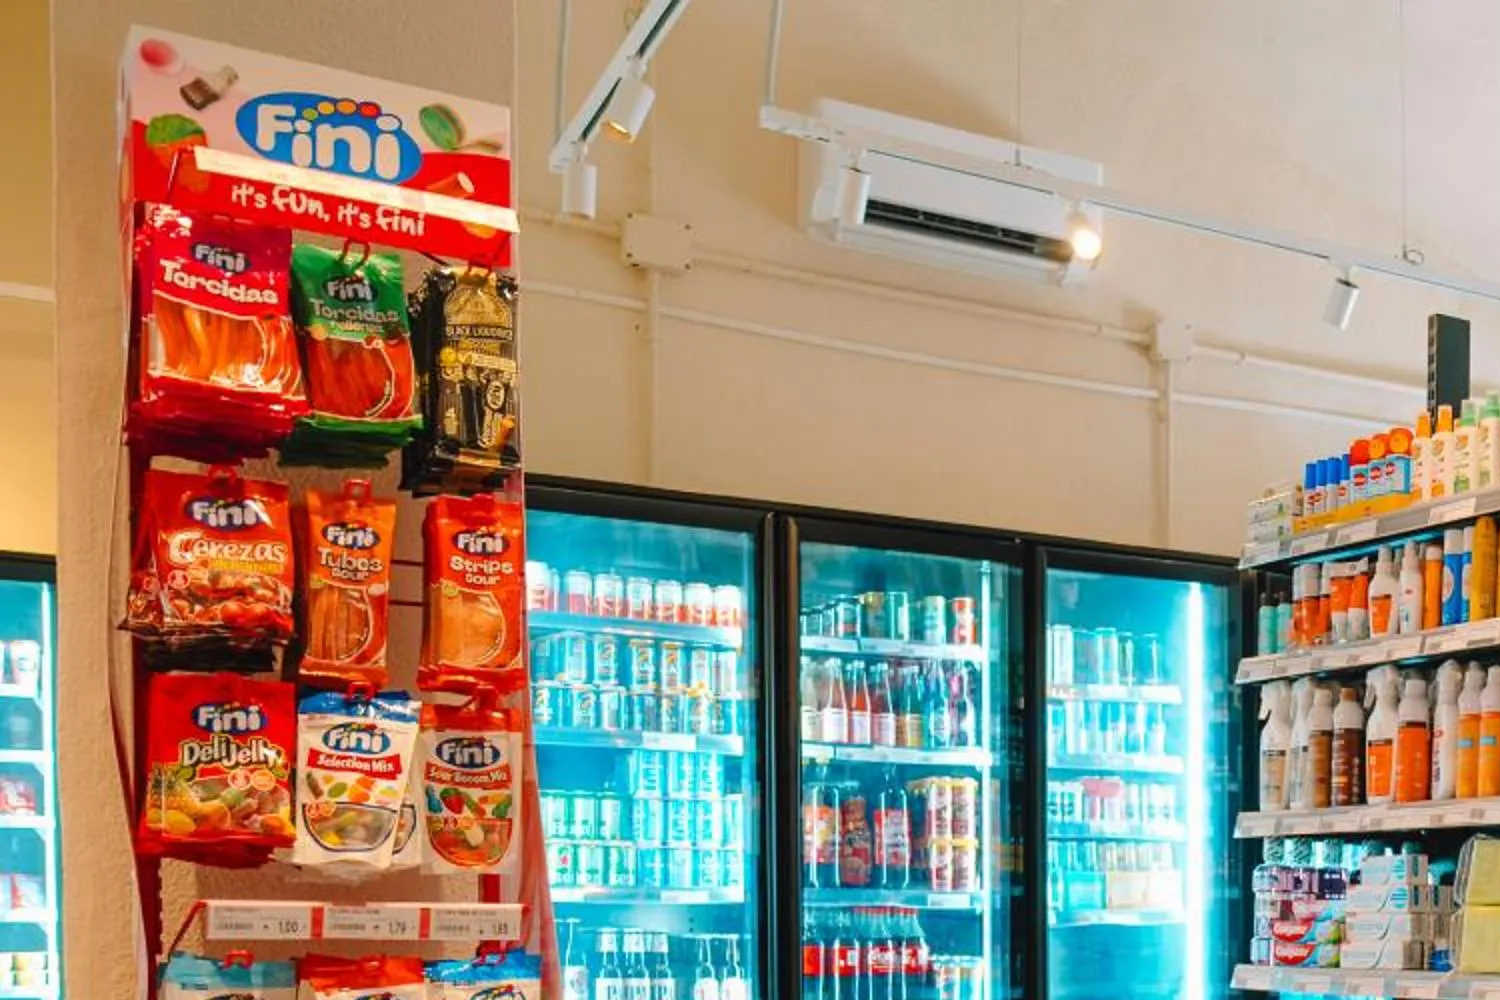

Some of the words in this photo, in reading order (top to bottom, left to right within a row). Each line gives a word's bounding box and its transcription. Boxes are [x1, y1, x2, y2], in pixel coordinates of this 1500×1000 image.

[255, 103, 403, 181] Fini
[232, 185, 267, 209] it's
[272, 184, 330, 221] fun,
[337, 205, 371, 230] it's
[375, 211, 426, 237] fini
[194, 243, 245, 274] Fini
[159, 259, 280, 305] Torcidas
[327, 278, 373, 301] Fini
[310, 299, 400, 325] Torcidas
[192, 500, 261, 528] Fini
[169, 532, 288, 565] Cerezas
[327, 526, 375, 548] Fini
[457, 532, 504, 553] Fini
[318, 547, 383, 572] Tubes
[450, 555, 514, 575] Strips
[465, 574, 501, 586] Sour
[197, 705, 262, 732] Fini
[327, 728, 384, 753] Fini
[317, 754, 371, 771] Selection
[371, 760, 396, 773] Mix
[440, 741, 494, 768] Fini
